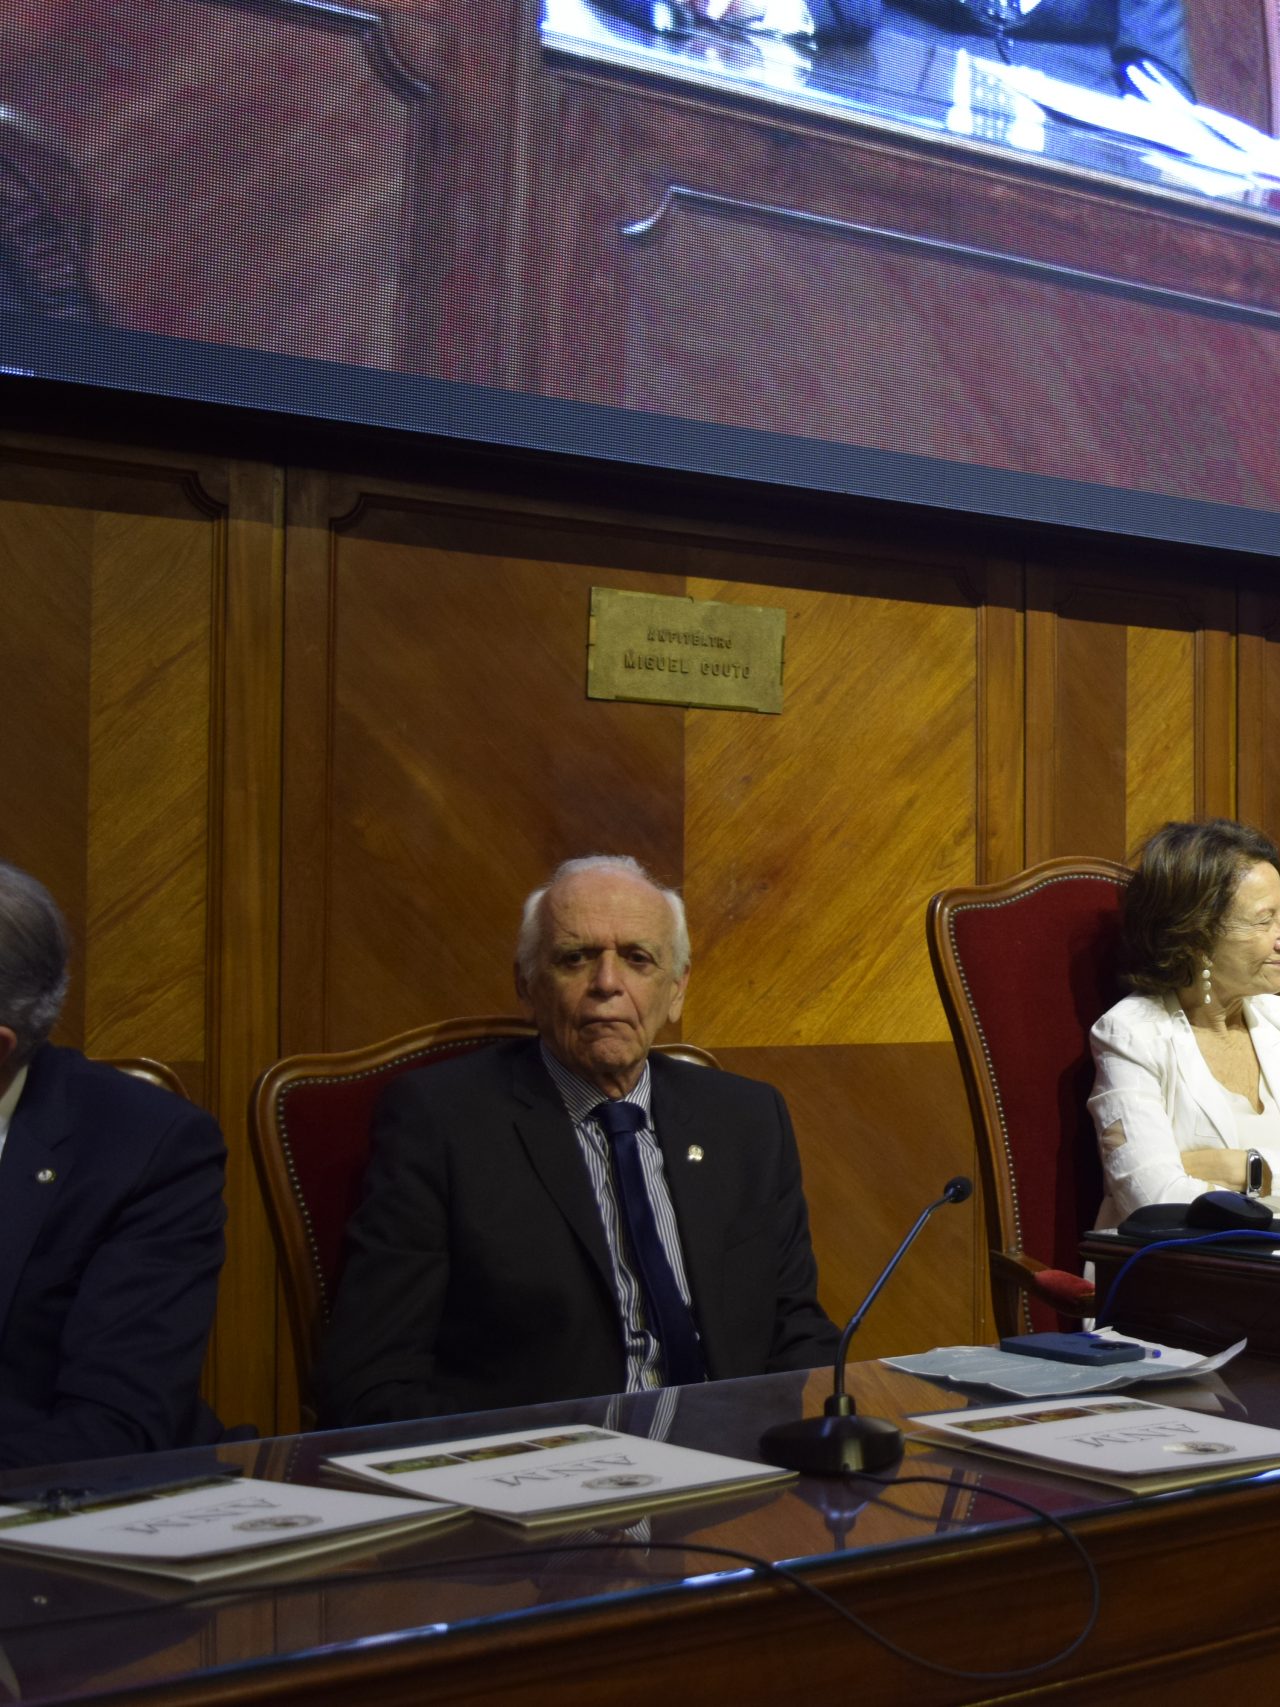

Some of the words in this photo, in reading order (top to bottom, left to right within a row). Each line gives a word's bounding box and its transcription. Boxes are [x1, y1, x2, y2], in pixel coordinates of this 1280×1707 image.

[623, 650, 690, 674] MIGUEL
[700, 661, 751, 680] COUTO
[1072, 1423, 1200, 1448] ANM
[492, 1455, 636, 1487] ANM
